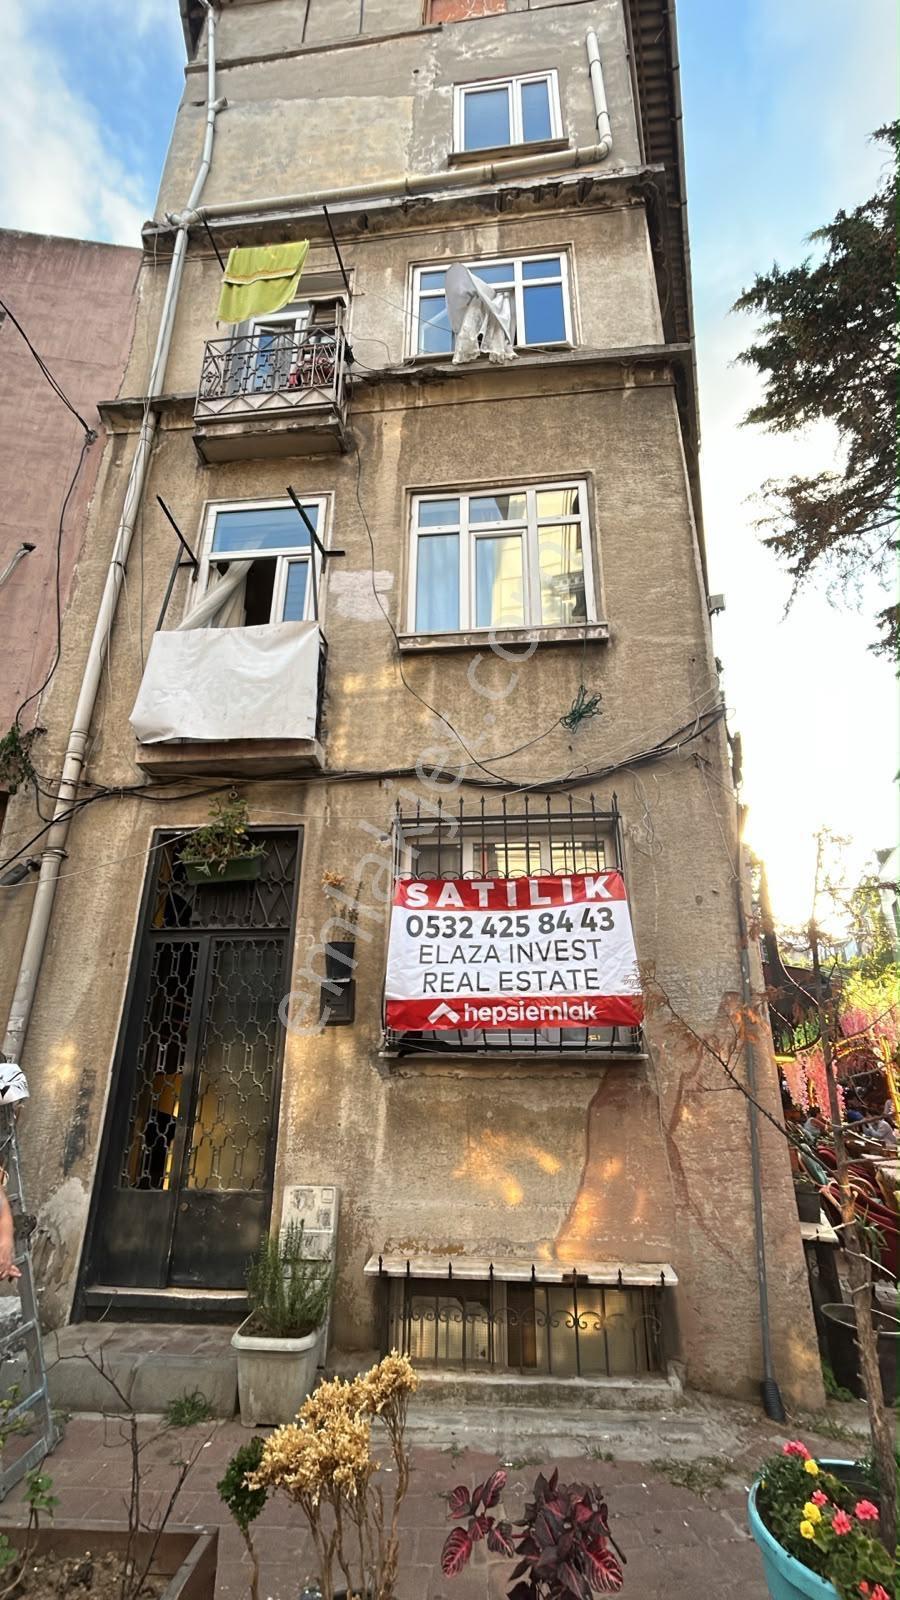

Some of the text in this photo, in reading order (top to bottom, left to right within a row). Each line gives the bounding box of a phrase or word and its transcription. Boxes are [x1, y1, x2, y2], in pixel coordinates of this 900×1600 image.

[405, 877, 612, 907] SATILIK
[406, 907, 615, 939] 0532 425 84 43
[419, 939, 602, 964] ELAZA INVEST
[423, 968, 600, 993] REAL ESTATE
[464, 1001, 598, 1025] hepsiemlak
